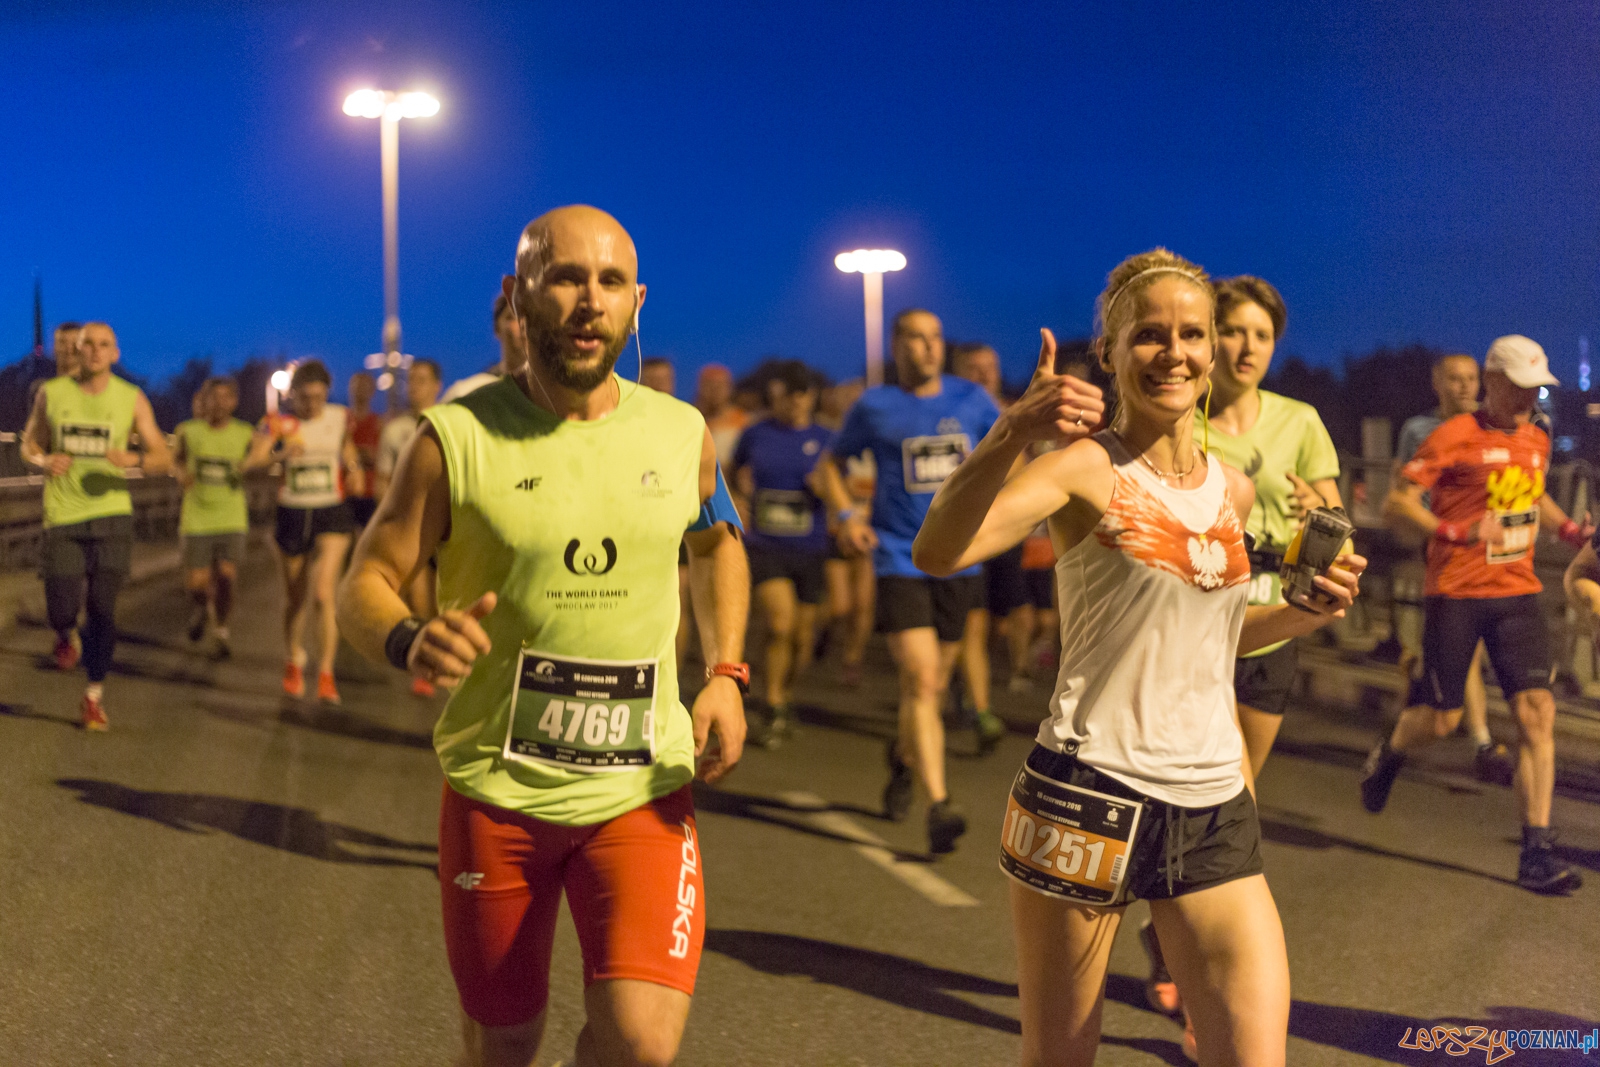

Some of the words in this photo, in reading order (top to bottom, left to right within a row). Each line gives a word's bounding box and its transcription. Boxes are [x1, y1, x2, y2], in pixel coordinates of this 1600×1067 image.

[546, 590, 563, 599] THE
[565, 589, 597, 599] WORLD
[600, 588, 628, 598] GAMES
[599, 602, 618, 610] 2017
[538, 699, 631, 747] 4769
[1066, 801, 1082, 812] 2016
[1006, 808, 1106, 882] 10251
[453, 871, 485, 890] 4F
[668, 821, 697, 959] POLSKA
